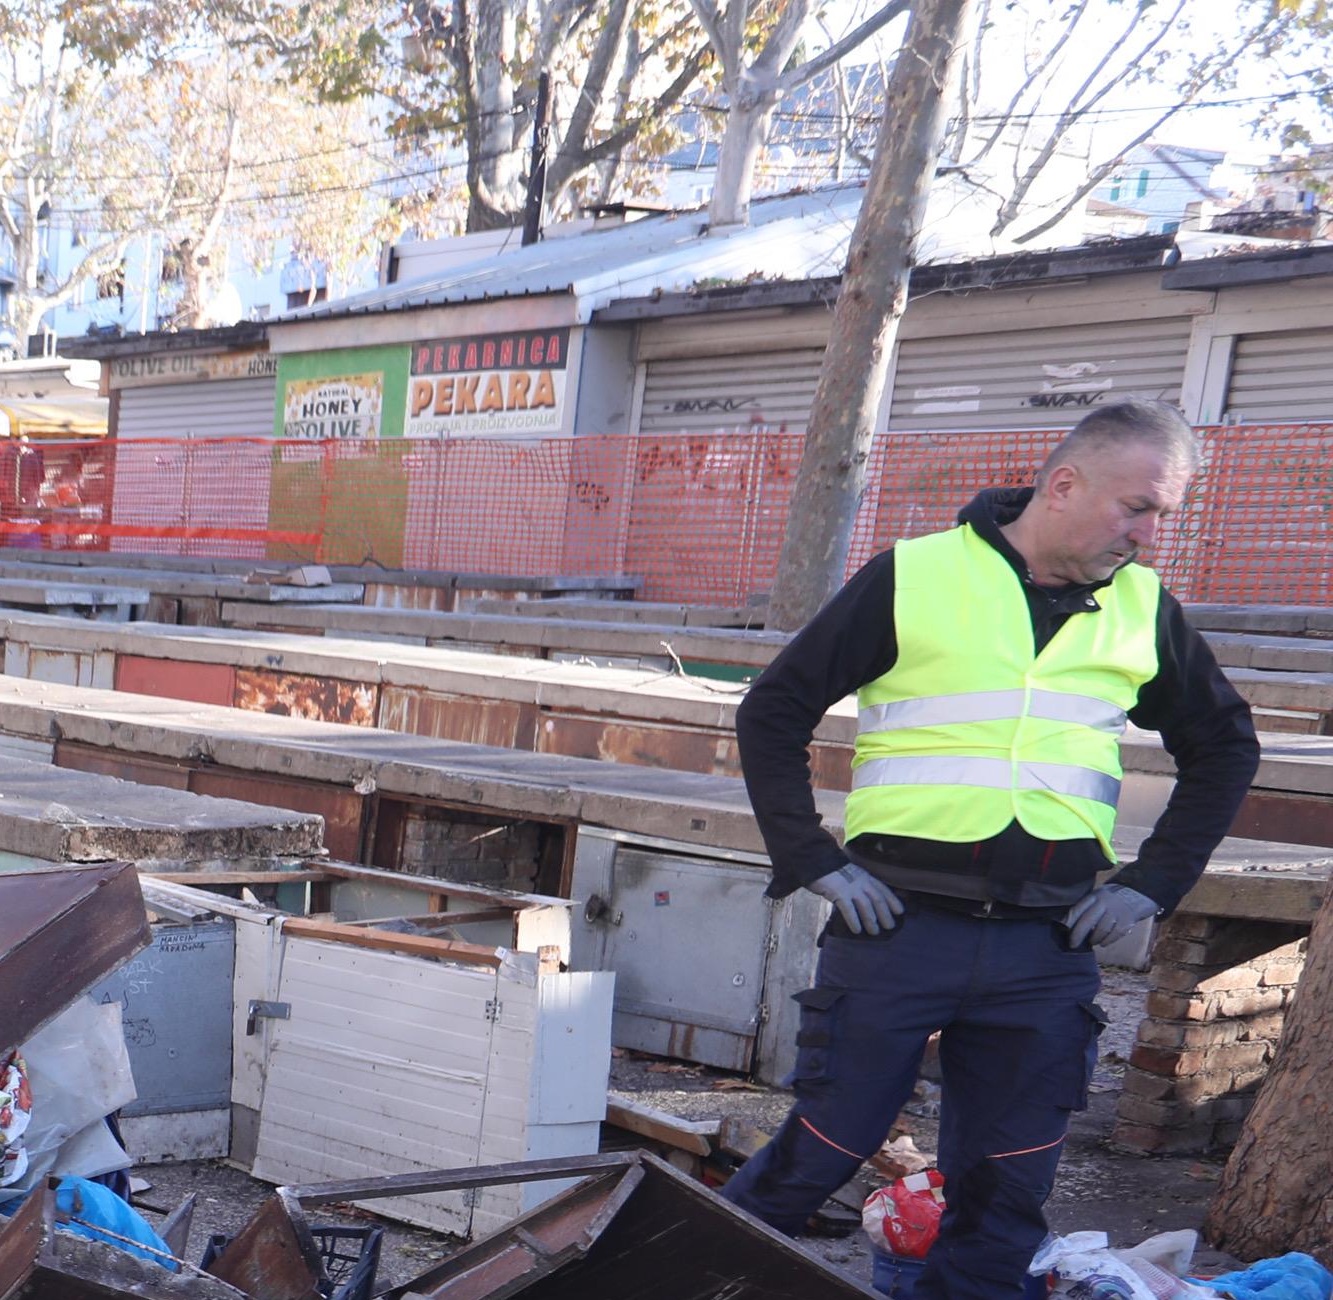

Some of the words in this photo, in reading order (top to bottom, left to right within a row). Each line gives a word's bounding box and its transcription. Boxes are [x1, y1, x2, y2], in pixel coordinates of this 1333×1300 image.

[118, 357, 166, 377] OLIVE
[171, 353, 198, 372] OIL
[416, 335, 560, 374] PEKARNICA
[410, 369, 556, 417] PEKARA
[302, 398, 362, 418] HONEY
[305, 419, 362, 439] OLIVE
